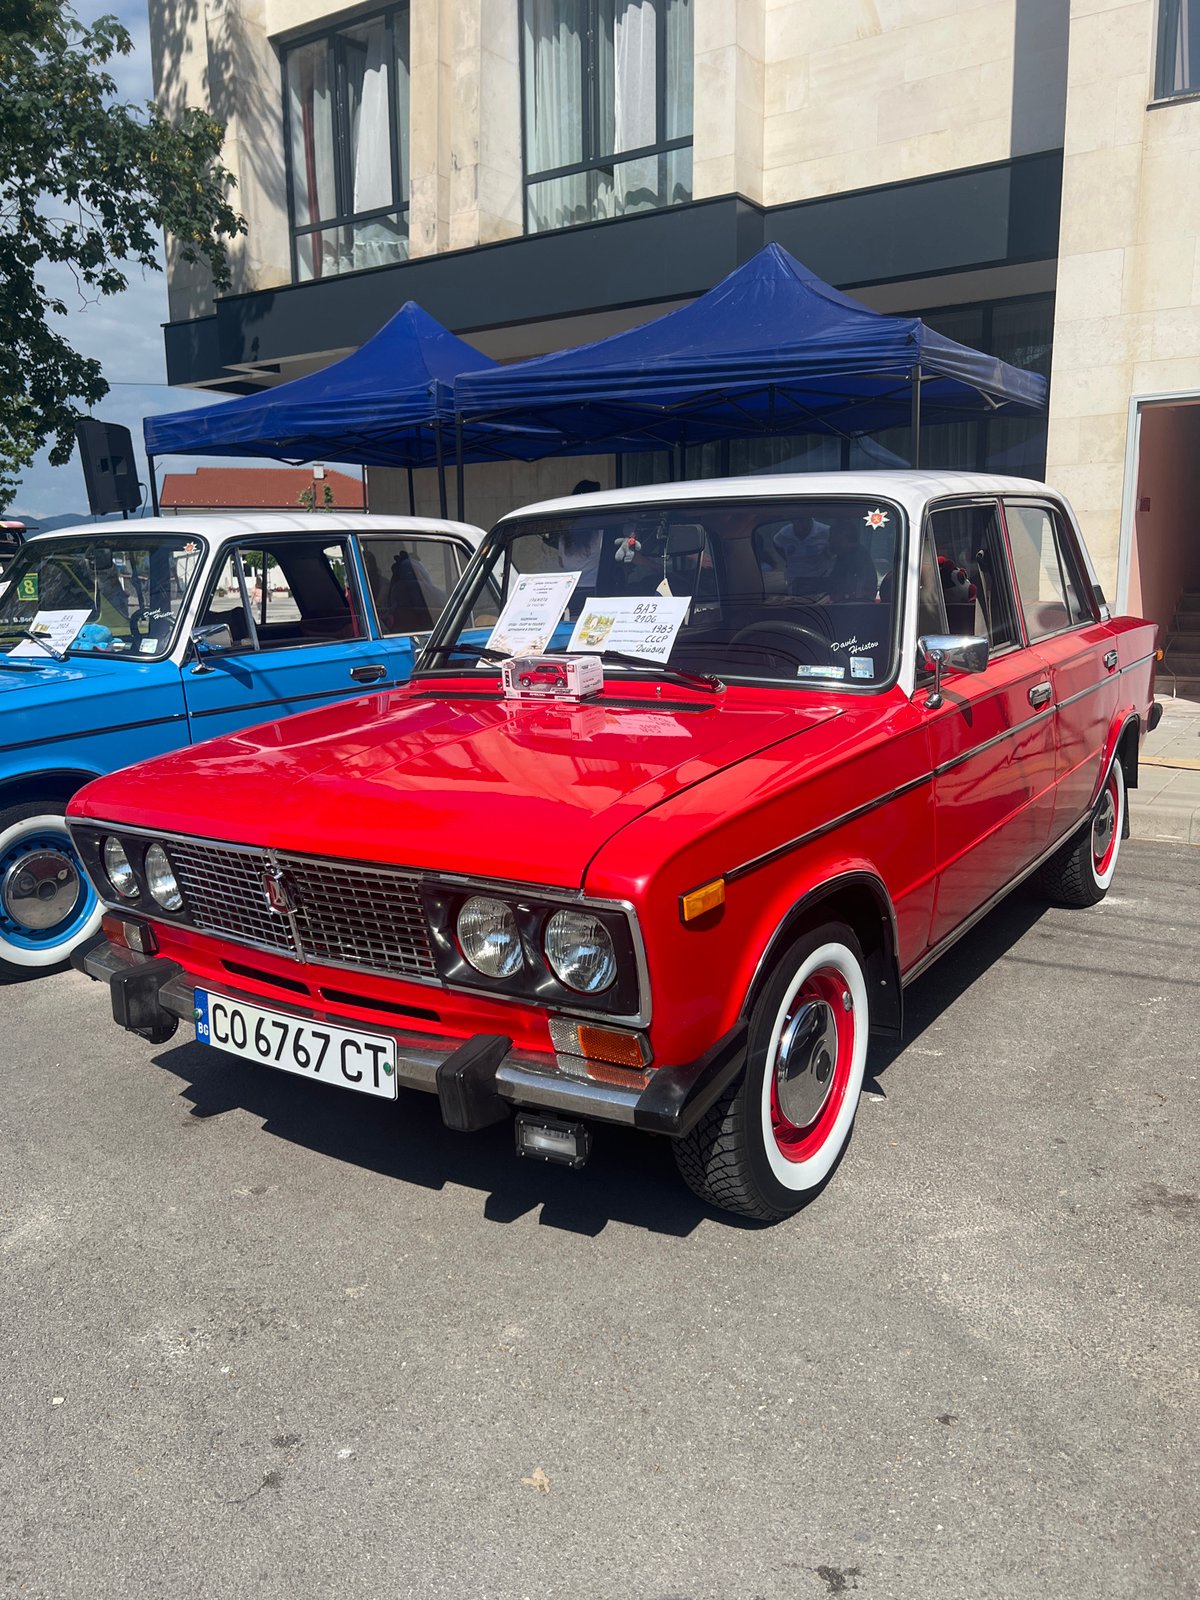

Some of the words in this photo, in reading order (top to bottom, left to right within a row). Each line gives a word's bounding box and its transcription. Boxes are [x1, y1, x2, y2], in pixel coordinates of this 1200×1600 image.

[24, 580, 35, 594] 8
[633, 603, 658, 614] ВАЗ
[831, 636, 857, 652] David
[849, 641, 879, 654] Hristov
[198, 1022, 209, 1036] BG
[212, 1003, 247, 1049] CO
[255, 1017, 331, 1073] 6767
[340, 1039, 387, 1088] CT
